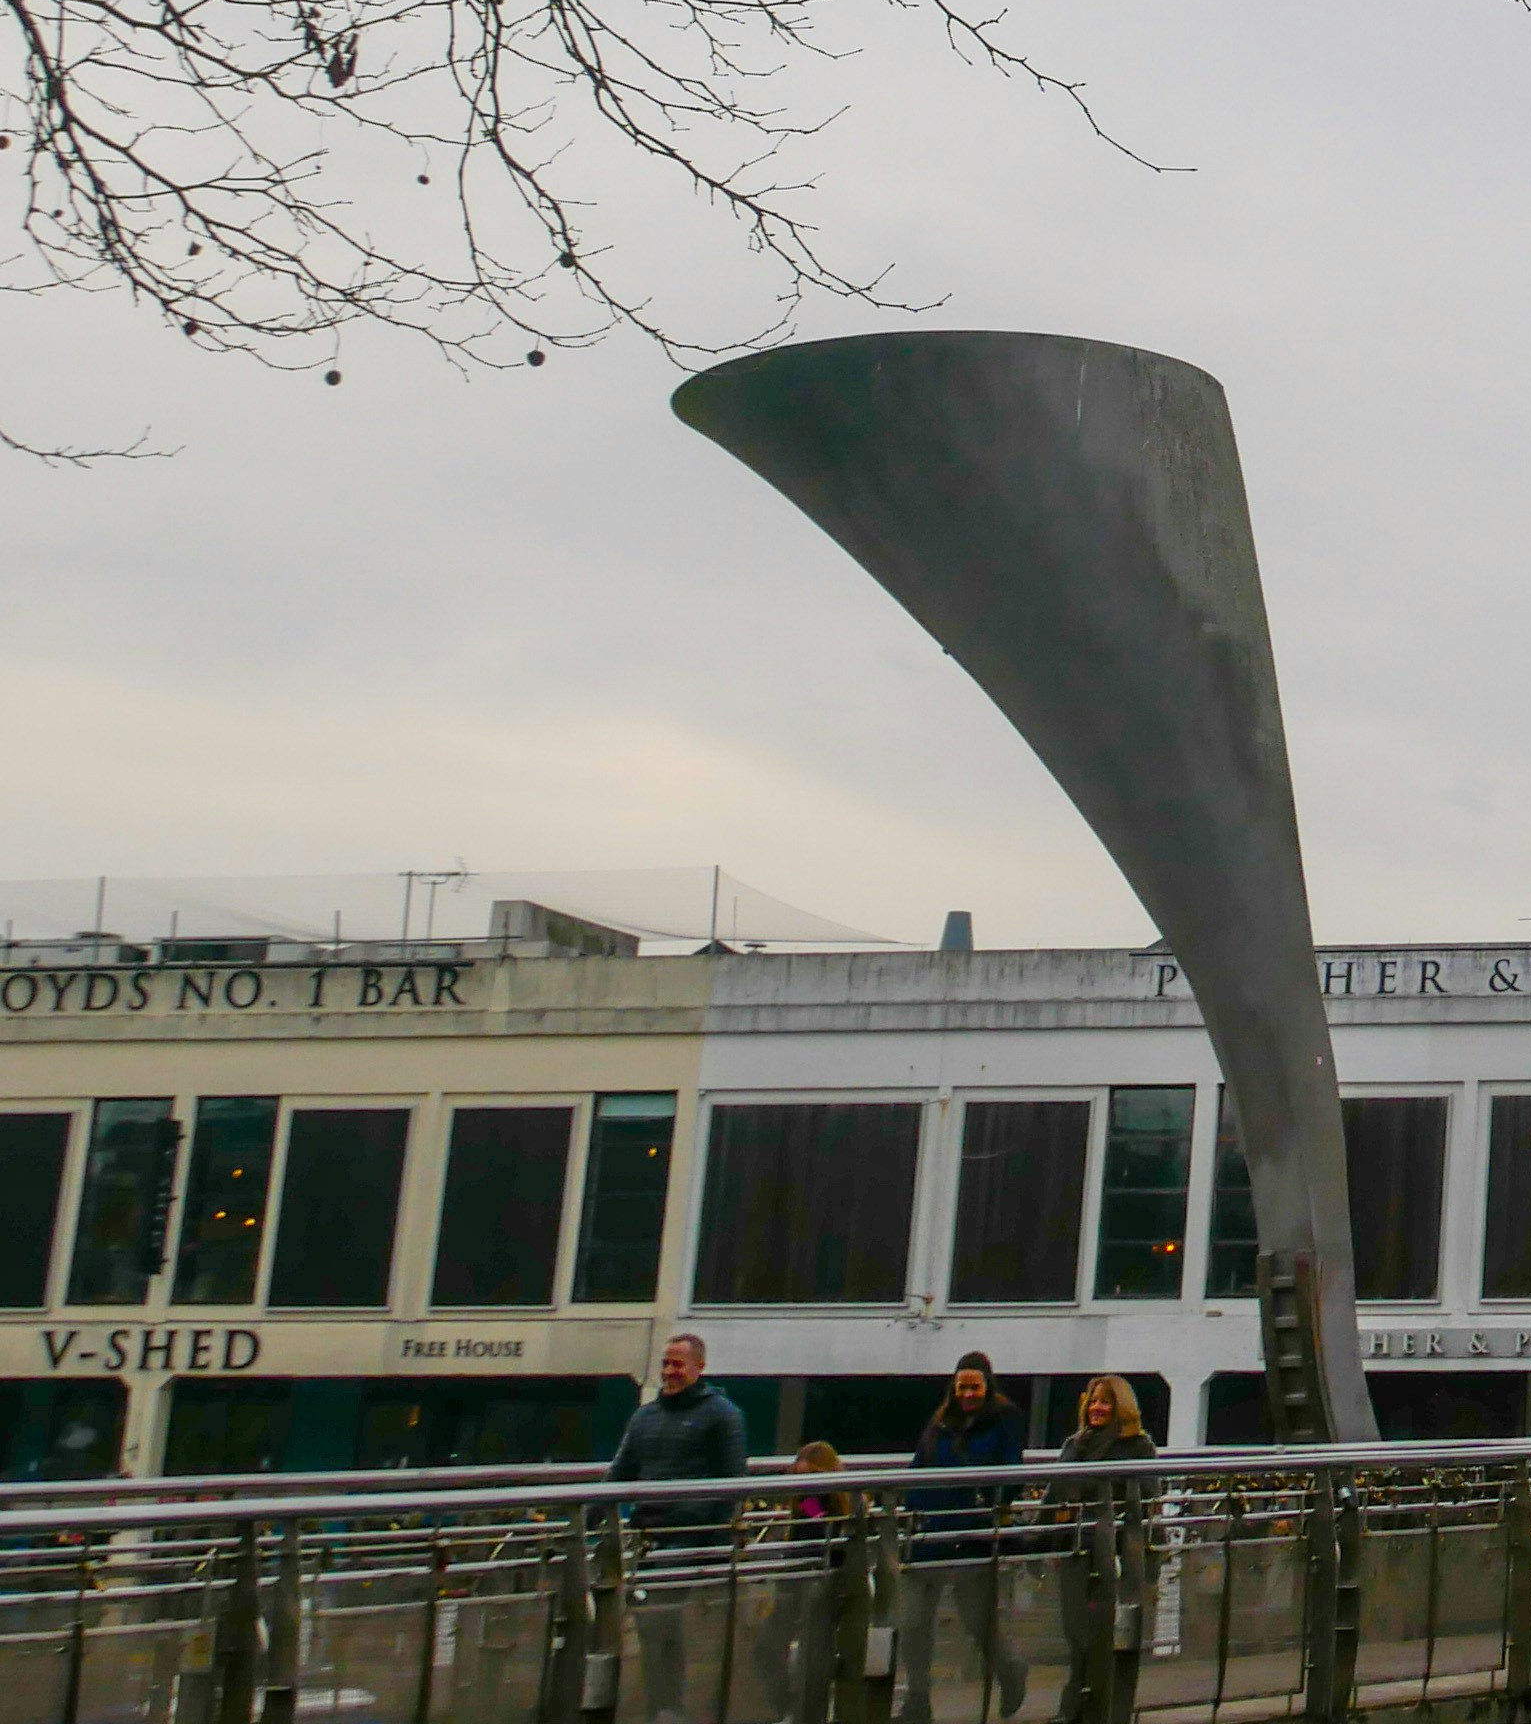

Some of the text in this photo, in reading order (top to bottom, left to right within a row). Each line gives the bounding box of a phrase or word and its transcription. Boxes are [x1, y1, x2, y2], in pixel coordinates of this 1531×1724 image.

[176, 969, 279, 1009] NO.
[307, 967, 328, 1008] 1
[355, 966, 468, 1008] BAR
[1154, 960, 1449, 997] PHER
[1487, 957, 1523, 993] &
[41, 1328, 263, 1372] V-SHED
[401, 1338, 525, 1359] FREE HOUSE
[1467, 1331, 1491, 1355] &
